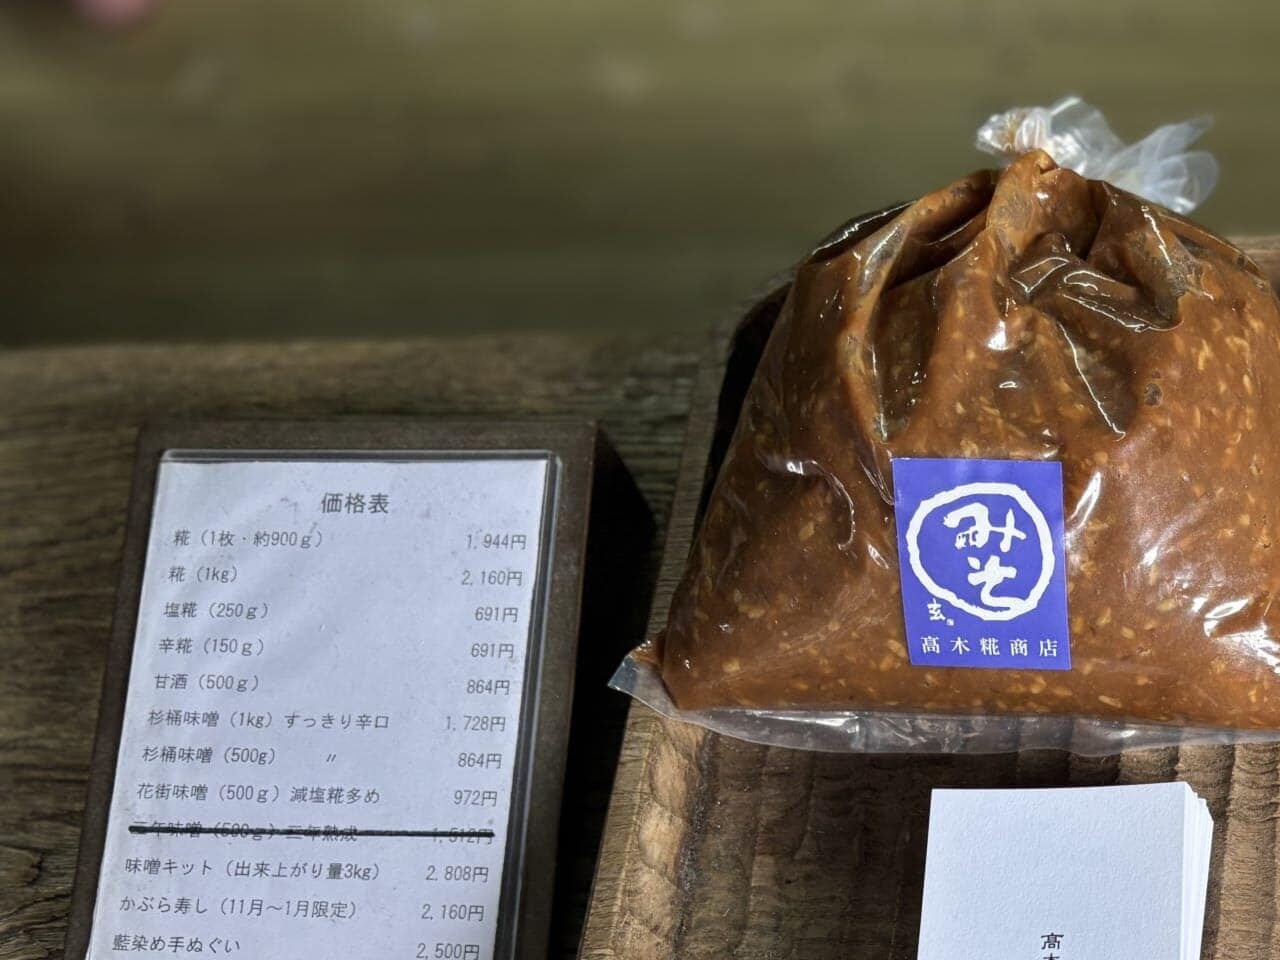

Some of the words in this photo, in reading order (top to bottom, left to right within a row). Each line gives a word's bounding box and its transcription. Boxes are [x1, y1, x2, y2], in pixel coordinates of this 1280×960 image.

[320, 491, 390, 515] 価格表
[466, 534, 527, 551] 1,944円
[462, 570, 523, 588] 2,160円
[474, 606, 519, 624] 691円
[471, 643, 515, 660] 691円
[466, 679, 511, 697] 864円
[446, 715, 506, 733] 1,728円
[458, 752, 502, 770] 864円
[453, 790, 498, 807] 972円
[426, 865, 489, 883] 2,808円
[421, 903, 484, 922] 2,160円
[112, 934, 241, 954] 藍染め手ぬぐい
[417, 942, 480, 960] 2,500円
